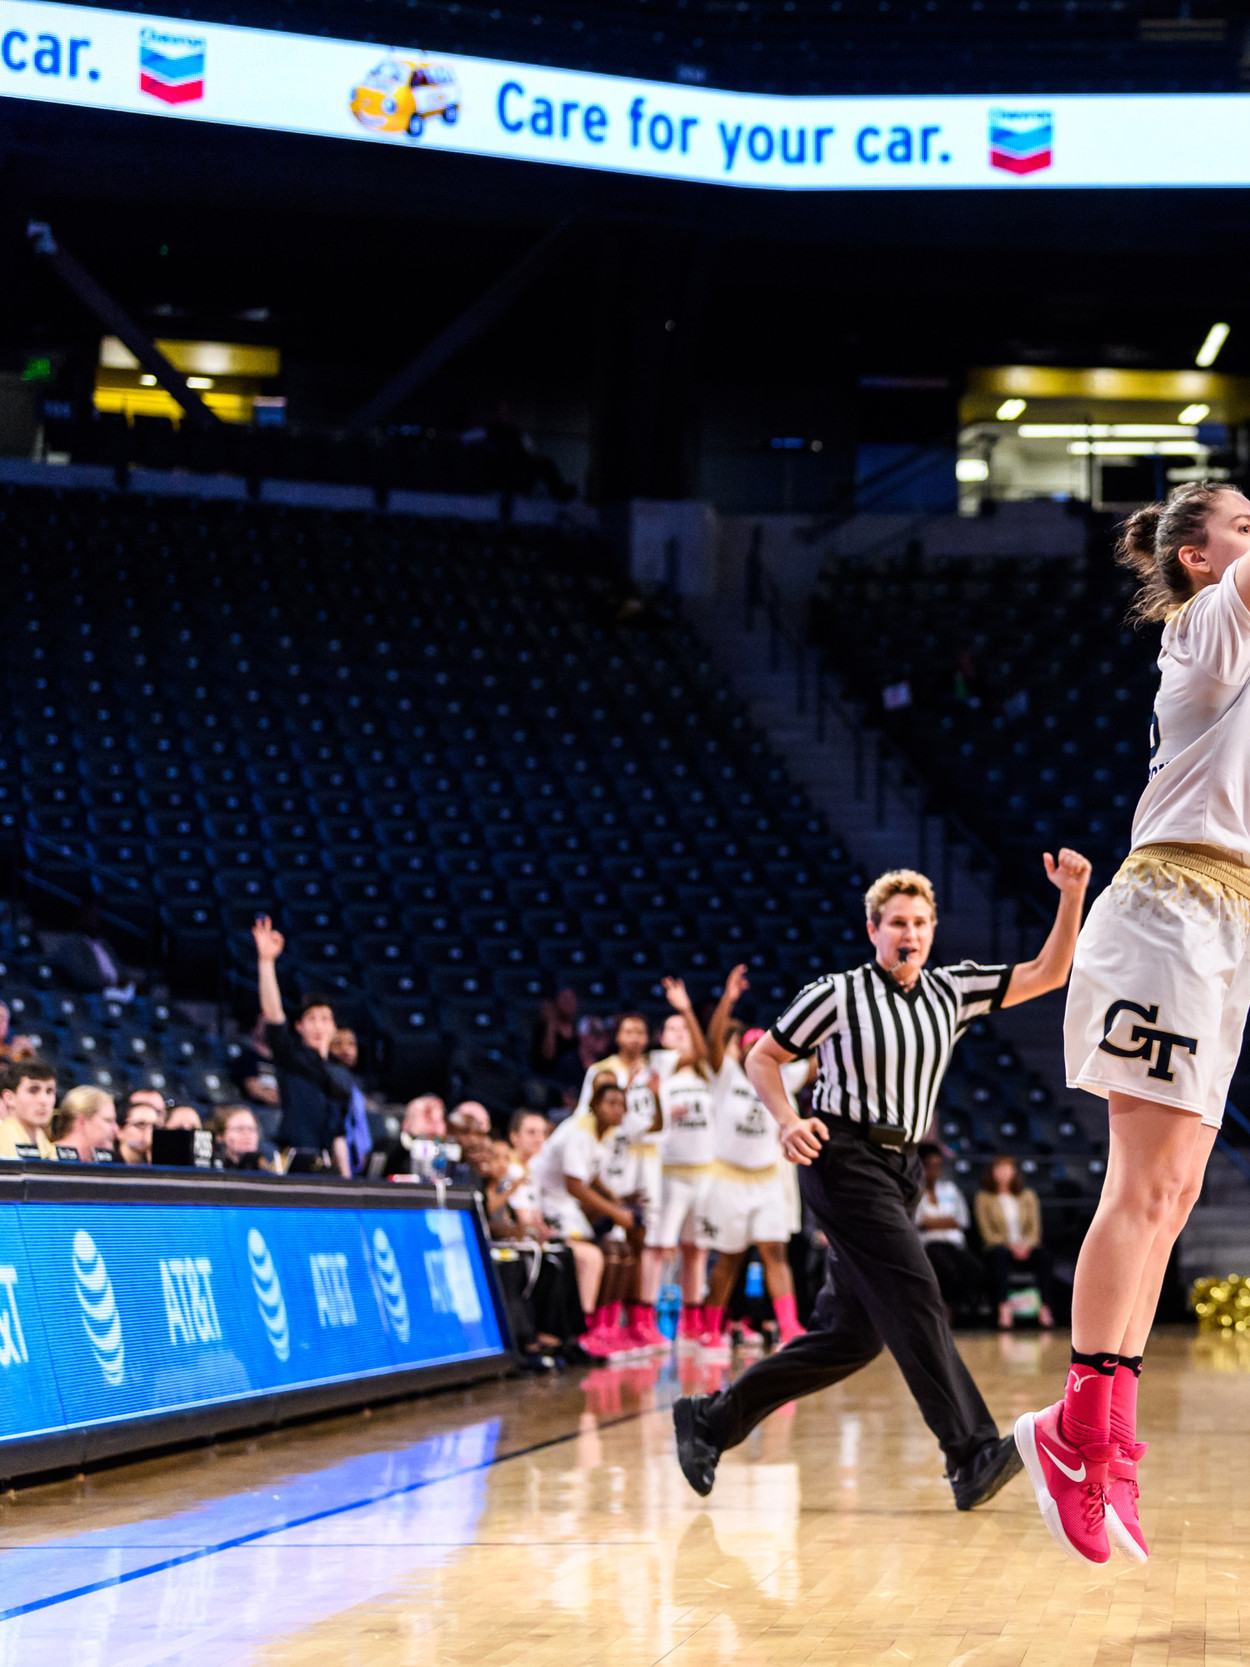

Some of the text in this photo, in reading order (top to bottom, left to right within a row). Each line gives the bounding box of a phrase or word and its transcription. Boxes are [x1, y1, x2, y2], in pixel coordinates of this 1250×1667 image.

[2, 27, 101, 82] car.
[497, 80, 952, 173] Care for your car.
[159, 1256, 223, 1346] AT&T
